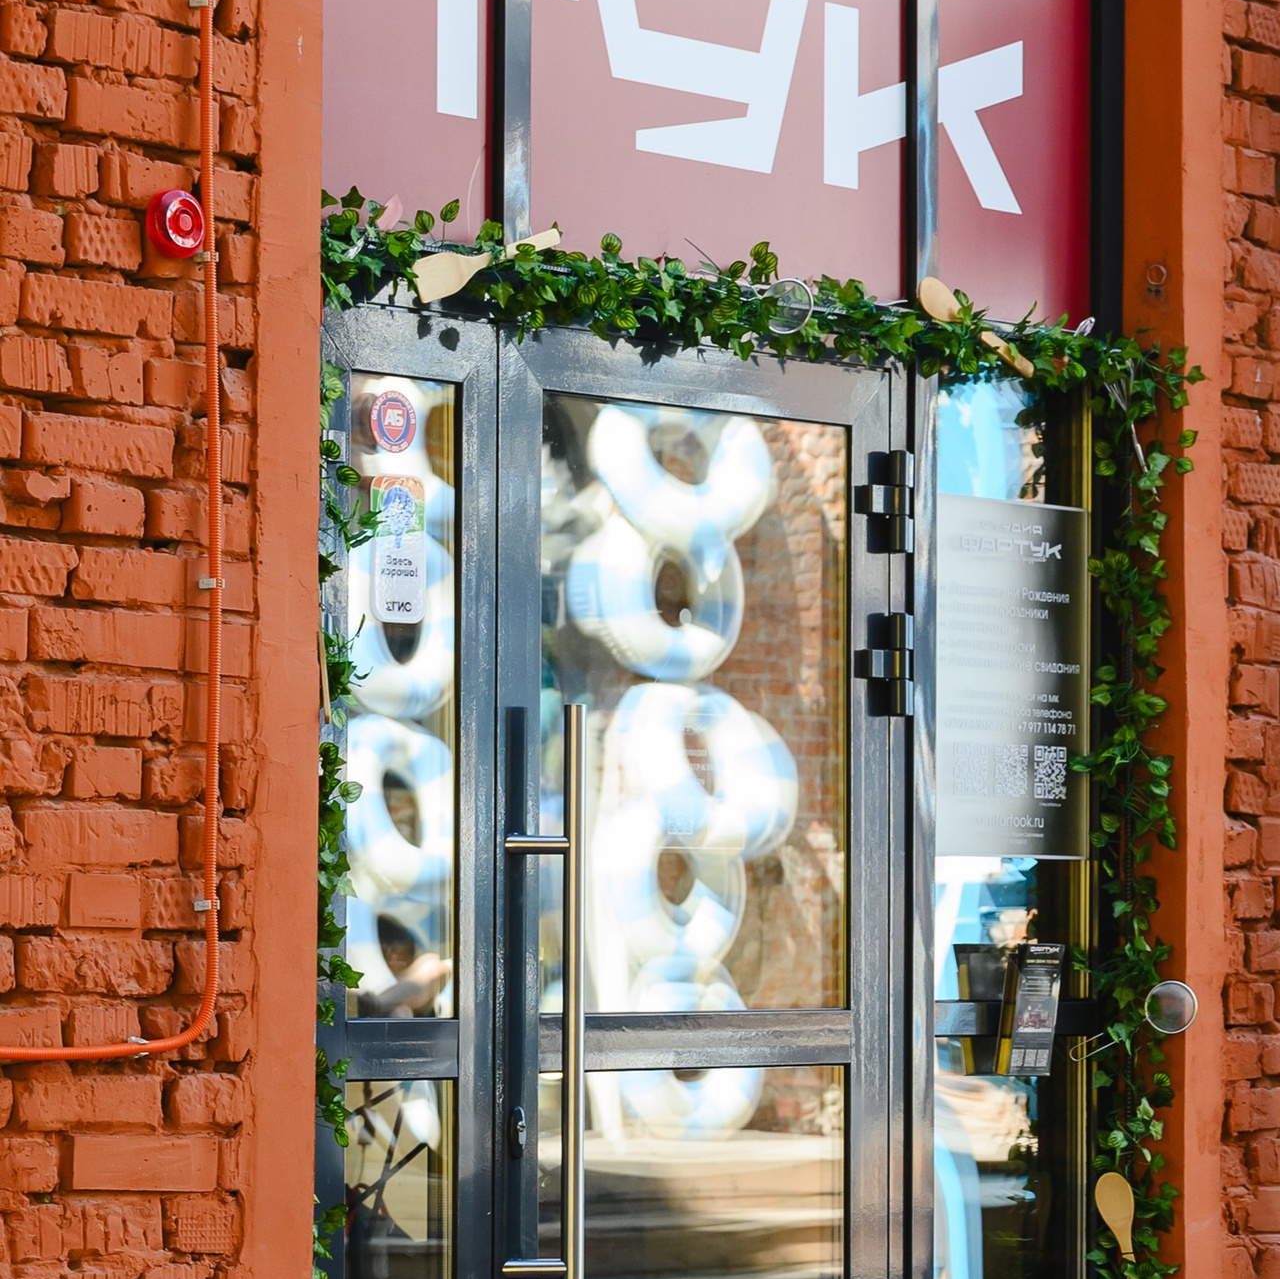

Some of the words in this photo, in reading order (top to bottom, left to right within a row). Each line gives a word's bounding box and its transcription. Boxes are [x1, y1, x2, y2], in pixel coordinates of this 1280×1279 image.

[384, 409, 405, 427] АБ
[961, 533, 1062, 559] ФАРТУК
[386, 554, 413, 566] Здесь
[1022, 587, 1070, 604] Рождения
[1034, 661, 1081, 674] свидания
